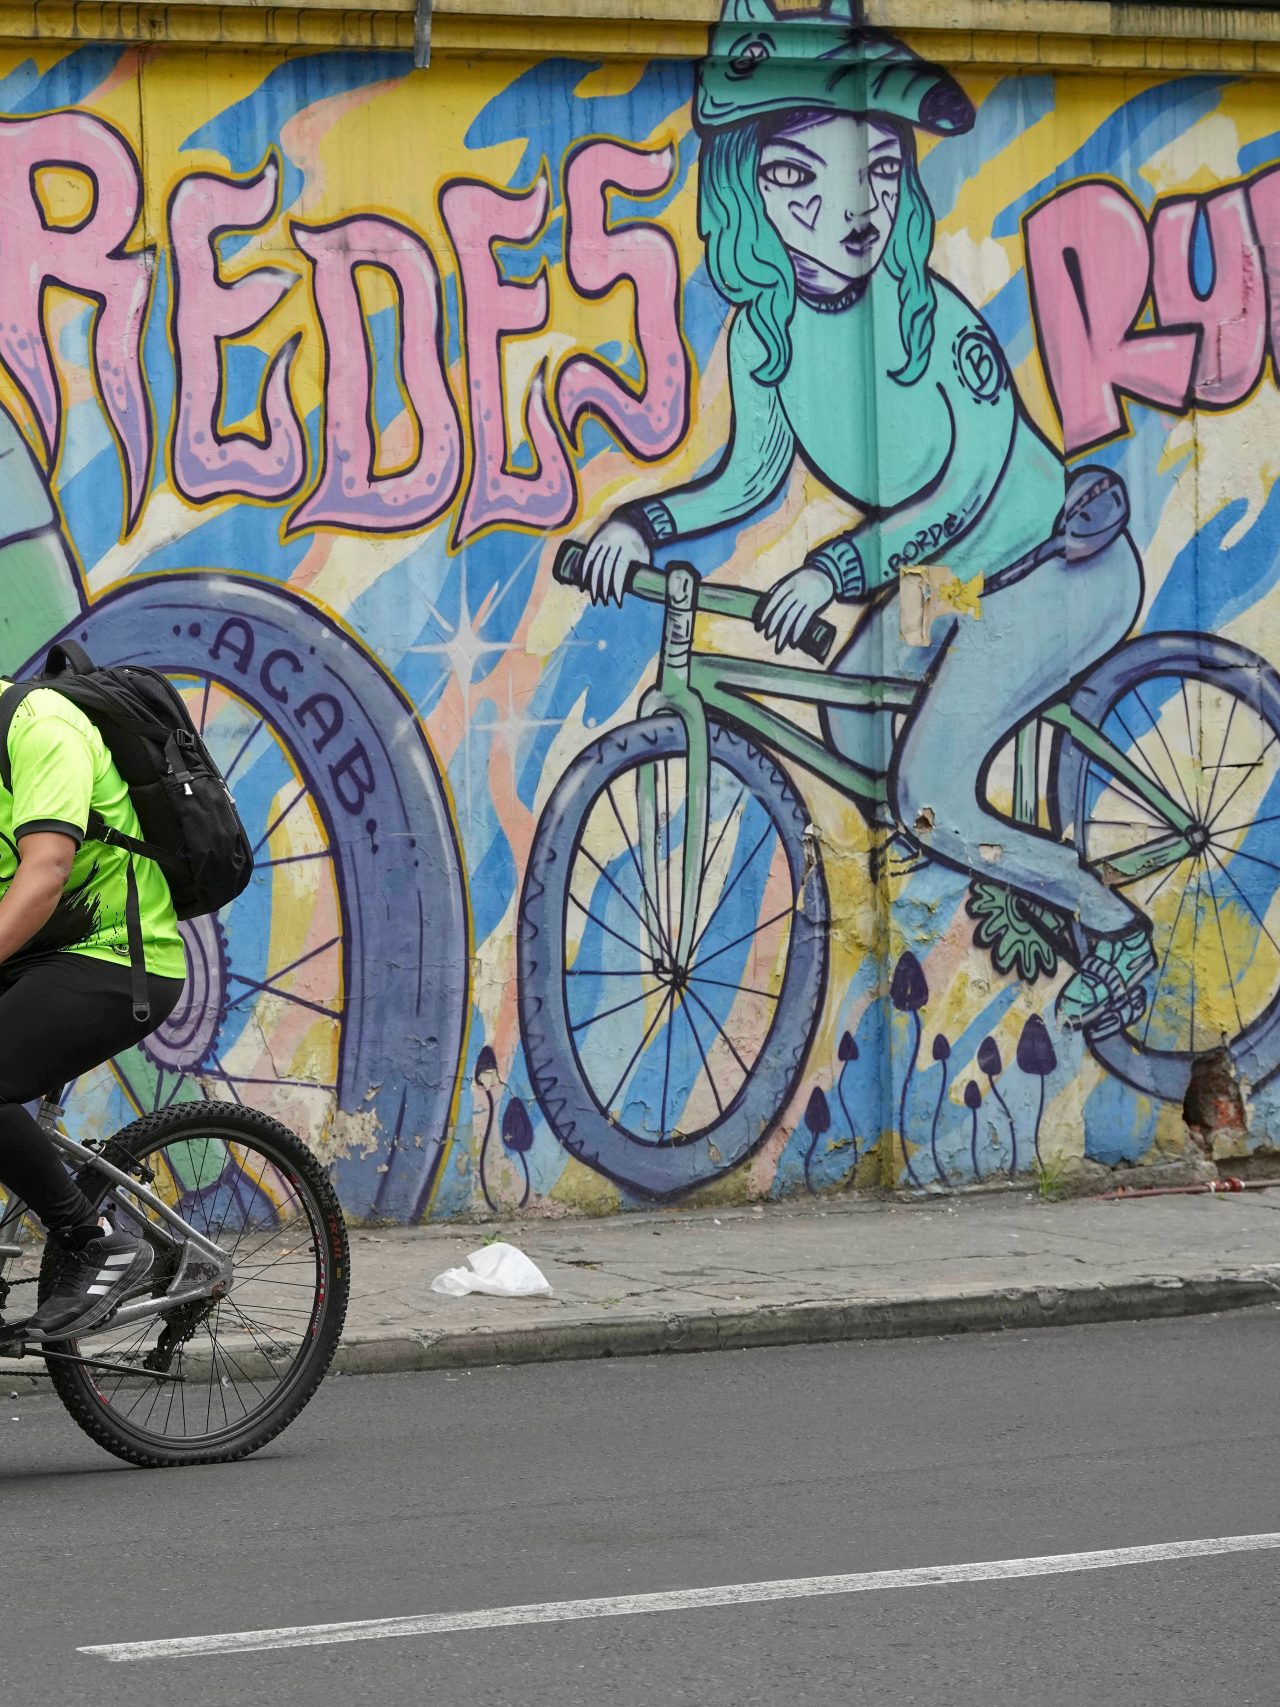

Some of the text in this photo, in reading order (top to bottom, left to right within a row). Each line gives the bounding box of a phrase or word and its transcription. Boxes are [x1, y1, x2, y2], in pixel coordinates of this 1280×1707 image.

[208, 617, 376, 816] ACAB
[301, 1163, 333, 1209] ALPINE
[326, 1210, 342, 1260] TRAIL
